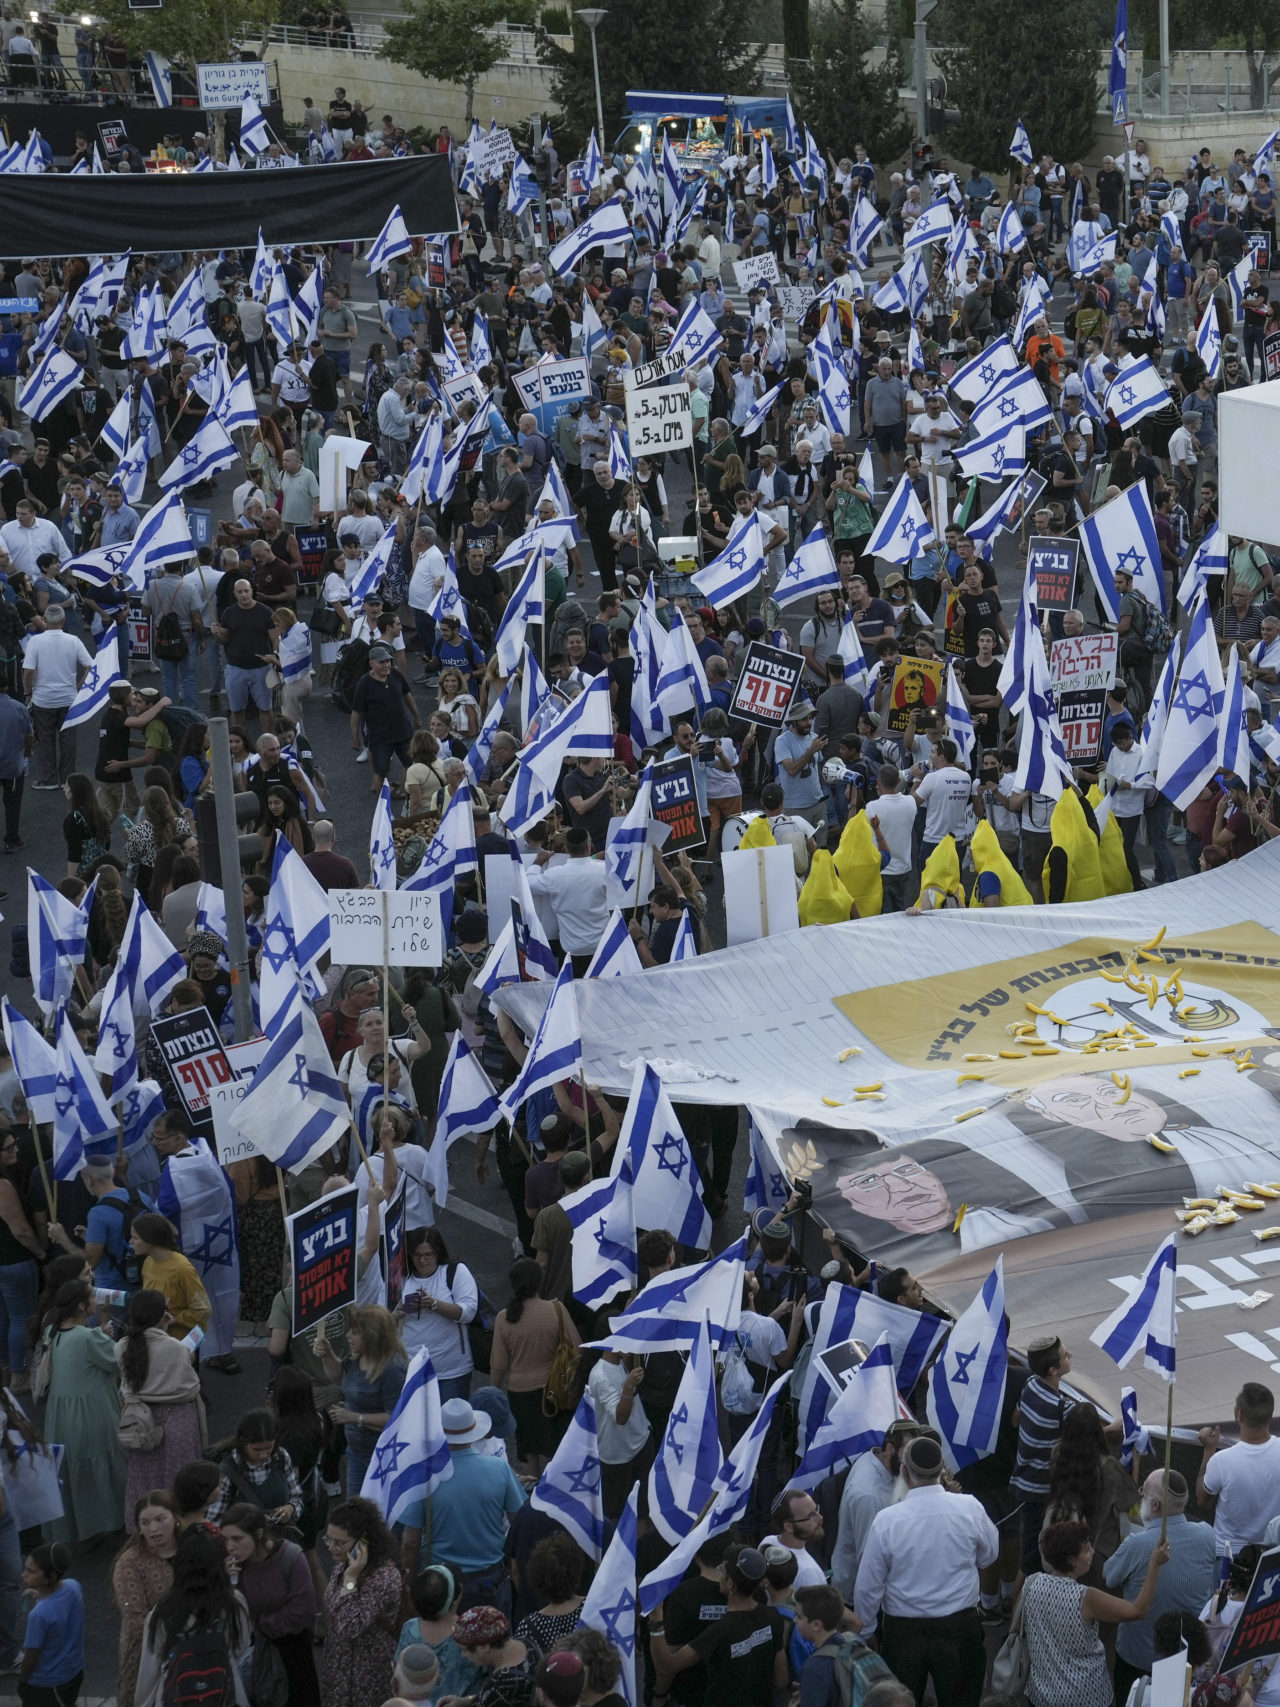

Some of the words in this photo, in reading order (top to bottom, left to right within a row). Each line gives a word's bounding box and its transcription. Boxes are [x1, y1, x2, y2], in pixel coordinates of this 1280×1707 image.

[204, 95, 219, 103] Ben
[542, 369, 585, 386] בוחרים
[549, 381, 582, 396] בנעם
[1034, 552, 1069, 570] בג״צ
[748, 656, 797, 684] נבצרות
[736, 699, 782, 719] הדמוקרטיה!
[1060, 702, 1102, 720] נבצרות
[655, 777, 690, 803] בג״צ
[684, 801, 695, 816] לא
[671, 815, 697, 840] אות
[410, 896, 432, 911] דיון
[331, 913, 382, 927] הברבור
[391, 915, 433, 930] שירת
[1008, 949, 1126, 995] הבננות
[958, 987, 1011, 1019] של
[162, 1027, 216, 1060] נבצרות
[302, 1217, 348, 1263] בג״צ
[334, 1248, 352, 1266] לא
[298, 1257, 332, 1289] תפסול
[301, 1267, 348, 1316] אותי!
